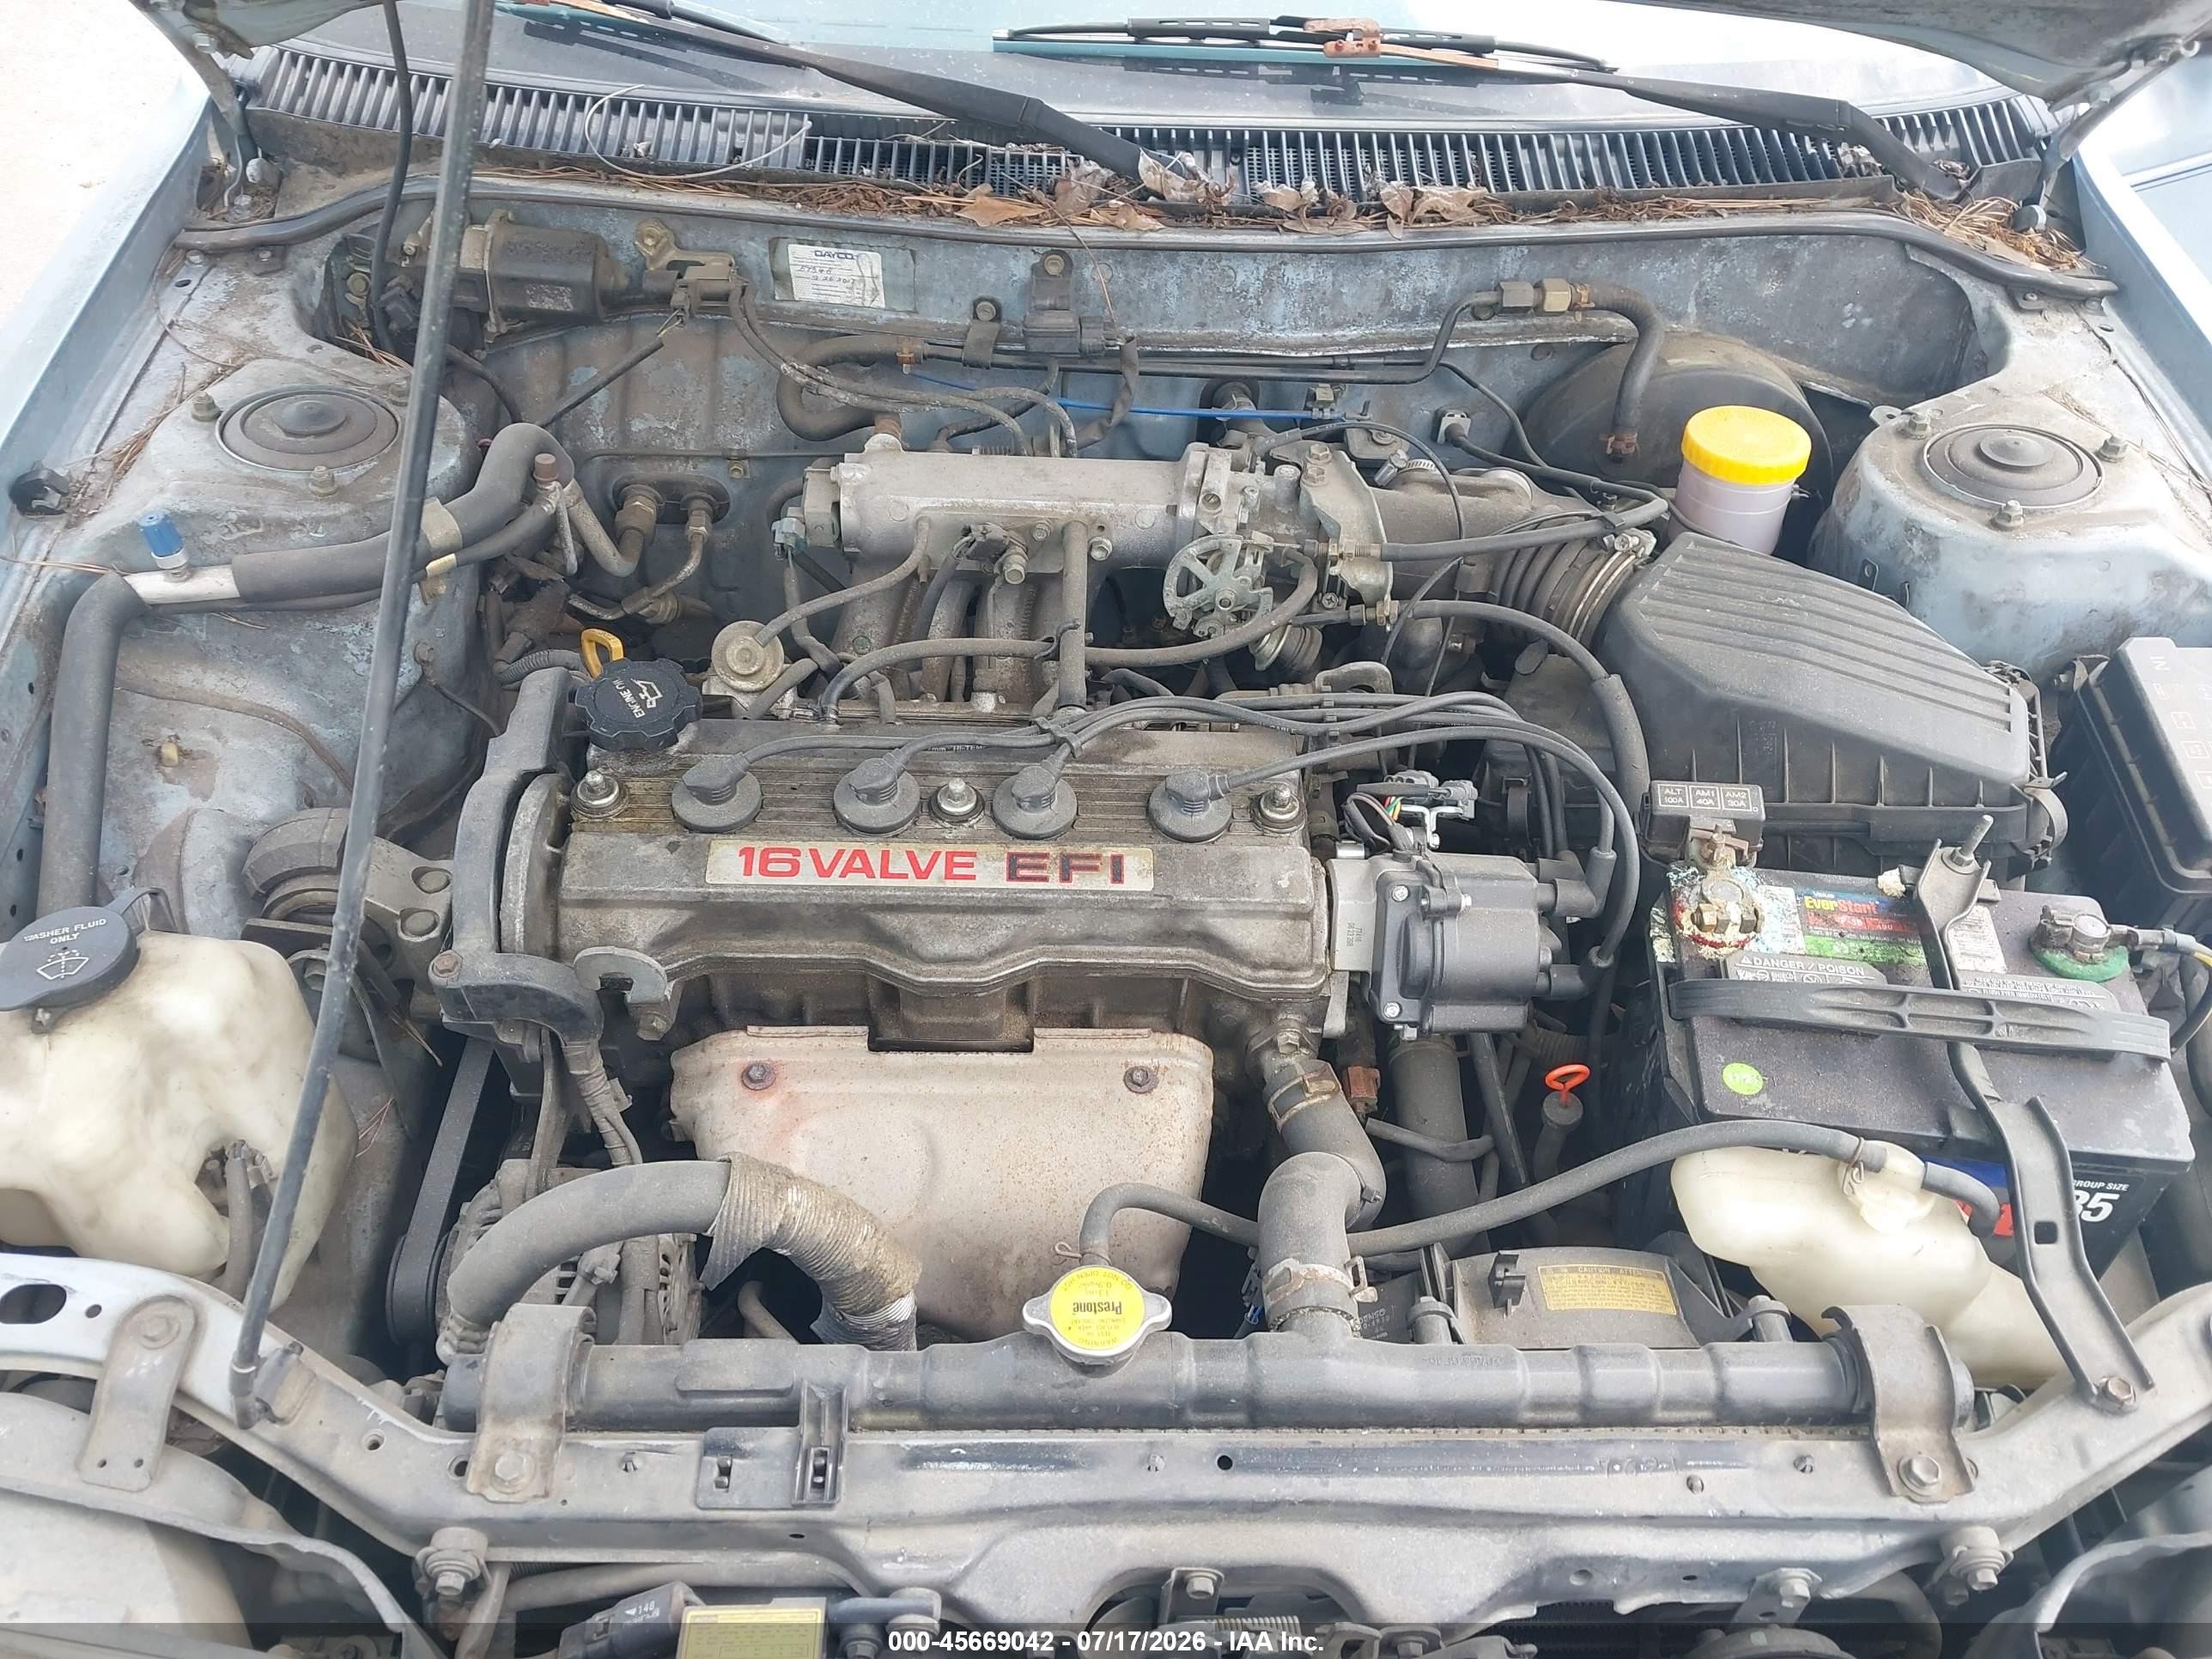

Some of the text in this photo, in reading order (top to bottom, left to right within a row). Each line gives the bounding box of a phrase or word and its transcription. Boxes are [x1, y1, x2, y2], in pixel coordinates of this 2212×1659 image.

[814, 250, 855, 260] DAYCO
[1005, 851, 1127, 885] EFI
[24, 919, 106, 942] WASHER FLUID
[50, 933, 80, 945] ONLY
[1753, 957, 1804, 971] DANGER
[1818, 963, 1865, 976] POISON
[2106, 1182, 2130, 1192] SIZE
[1077, 1270, 1099, 1279] OPEN
[1103, 1271, 1120, 1280] NOT
[1073, 1301, 1122, 1316] Prestone
[1078, 1338, 1118, 1347] WARNING
